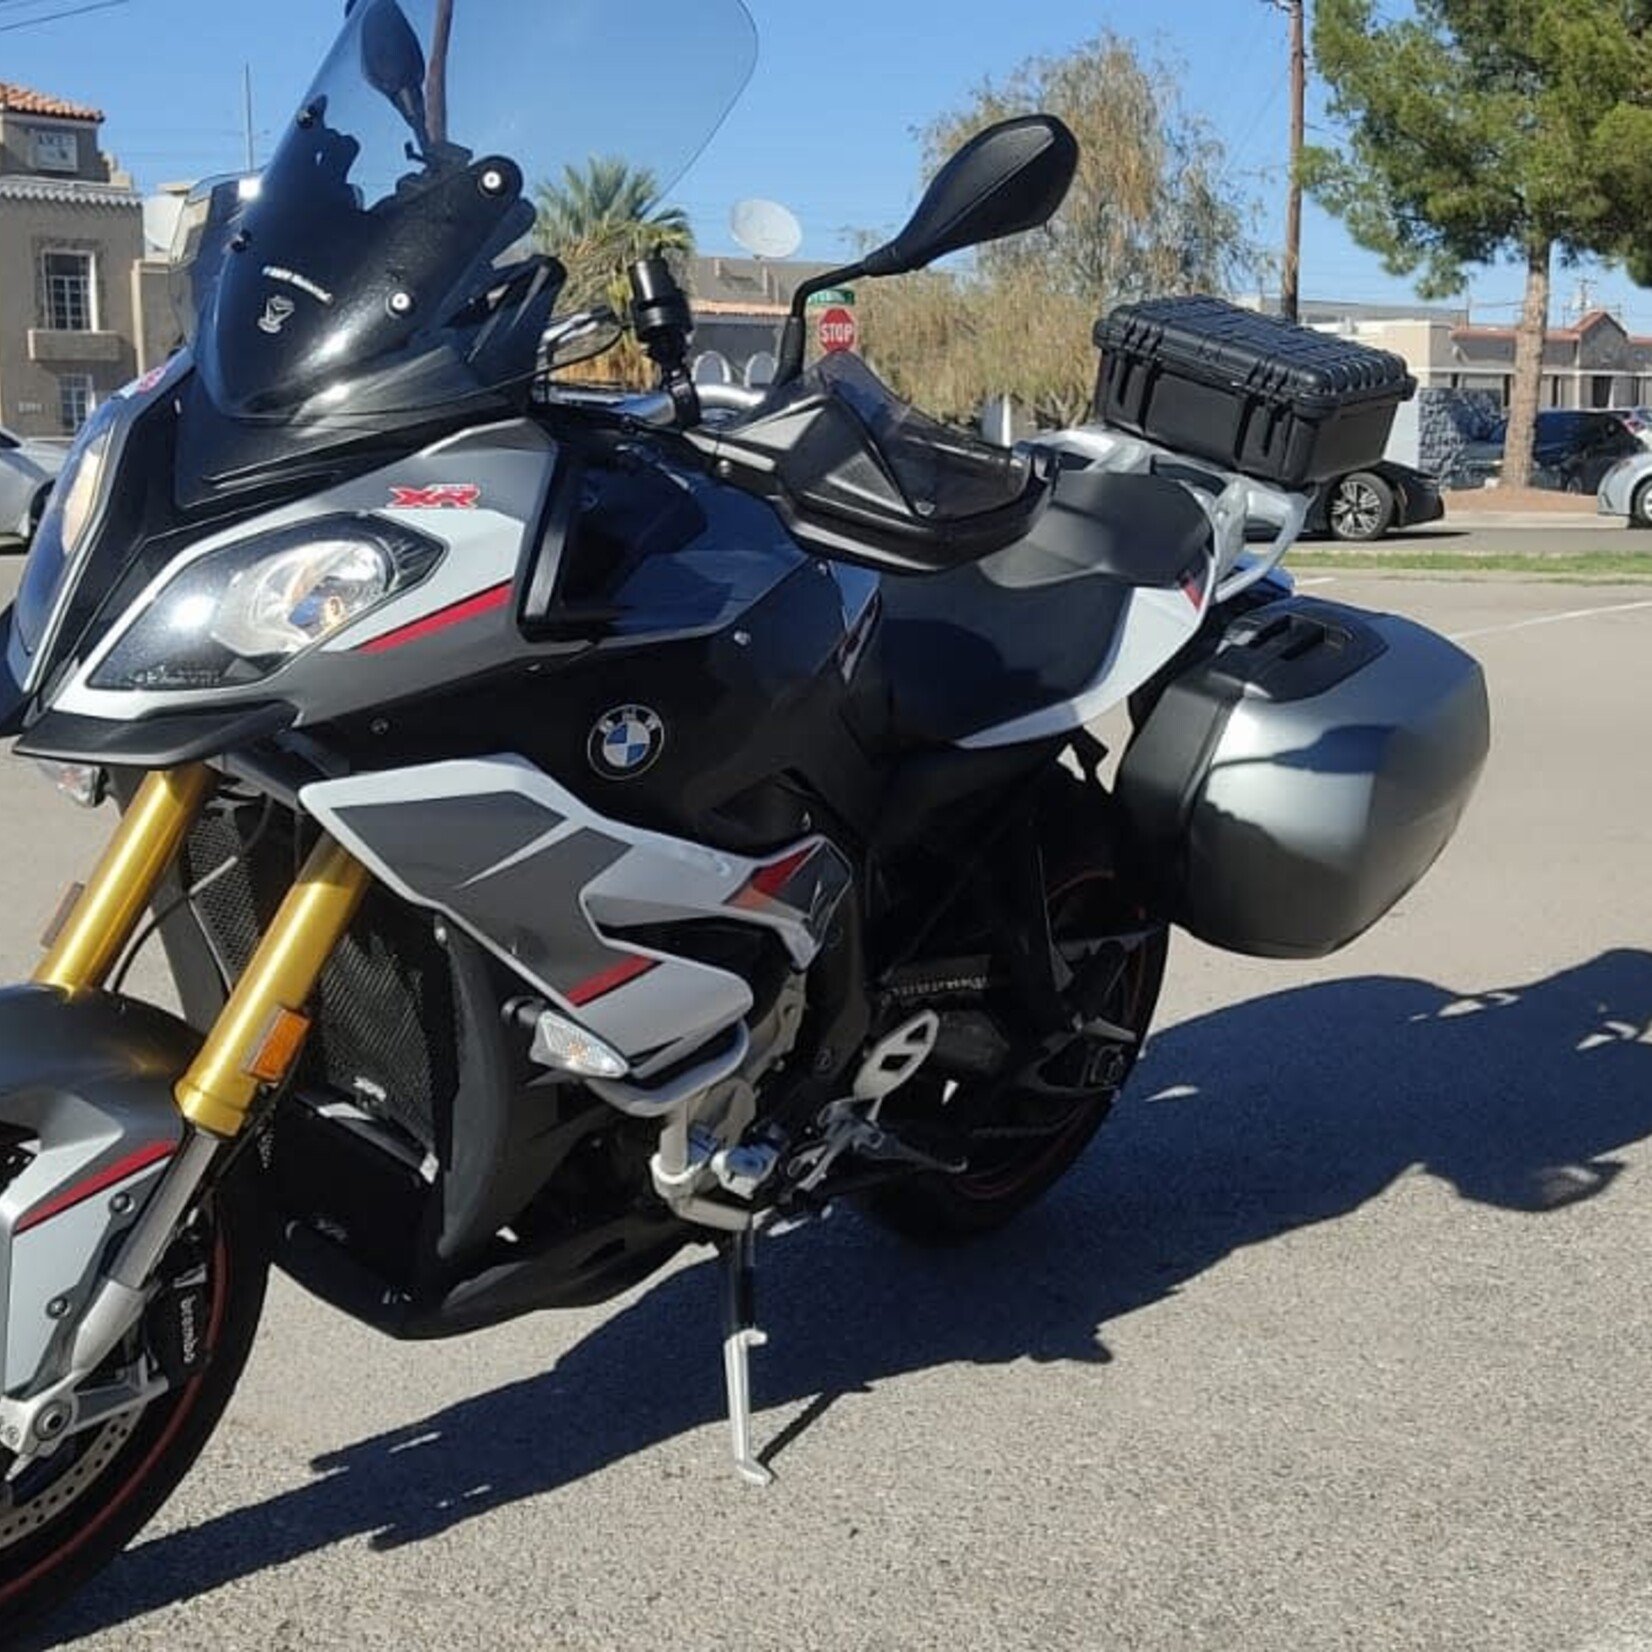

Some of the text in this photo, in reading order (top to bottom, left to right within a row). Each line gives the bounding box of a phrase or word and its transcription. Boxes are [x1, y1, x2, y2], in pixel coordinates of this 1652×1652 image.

[820, 322, 853, 343] STOP
[385, 483, 480, 509] XR
[598, 706, 661, 733] BMW
[180, 1294, 199, 1364] brembo
